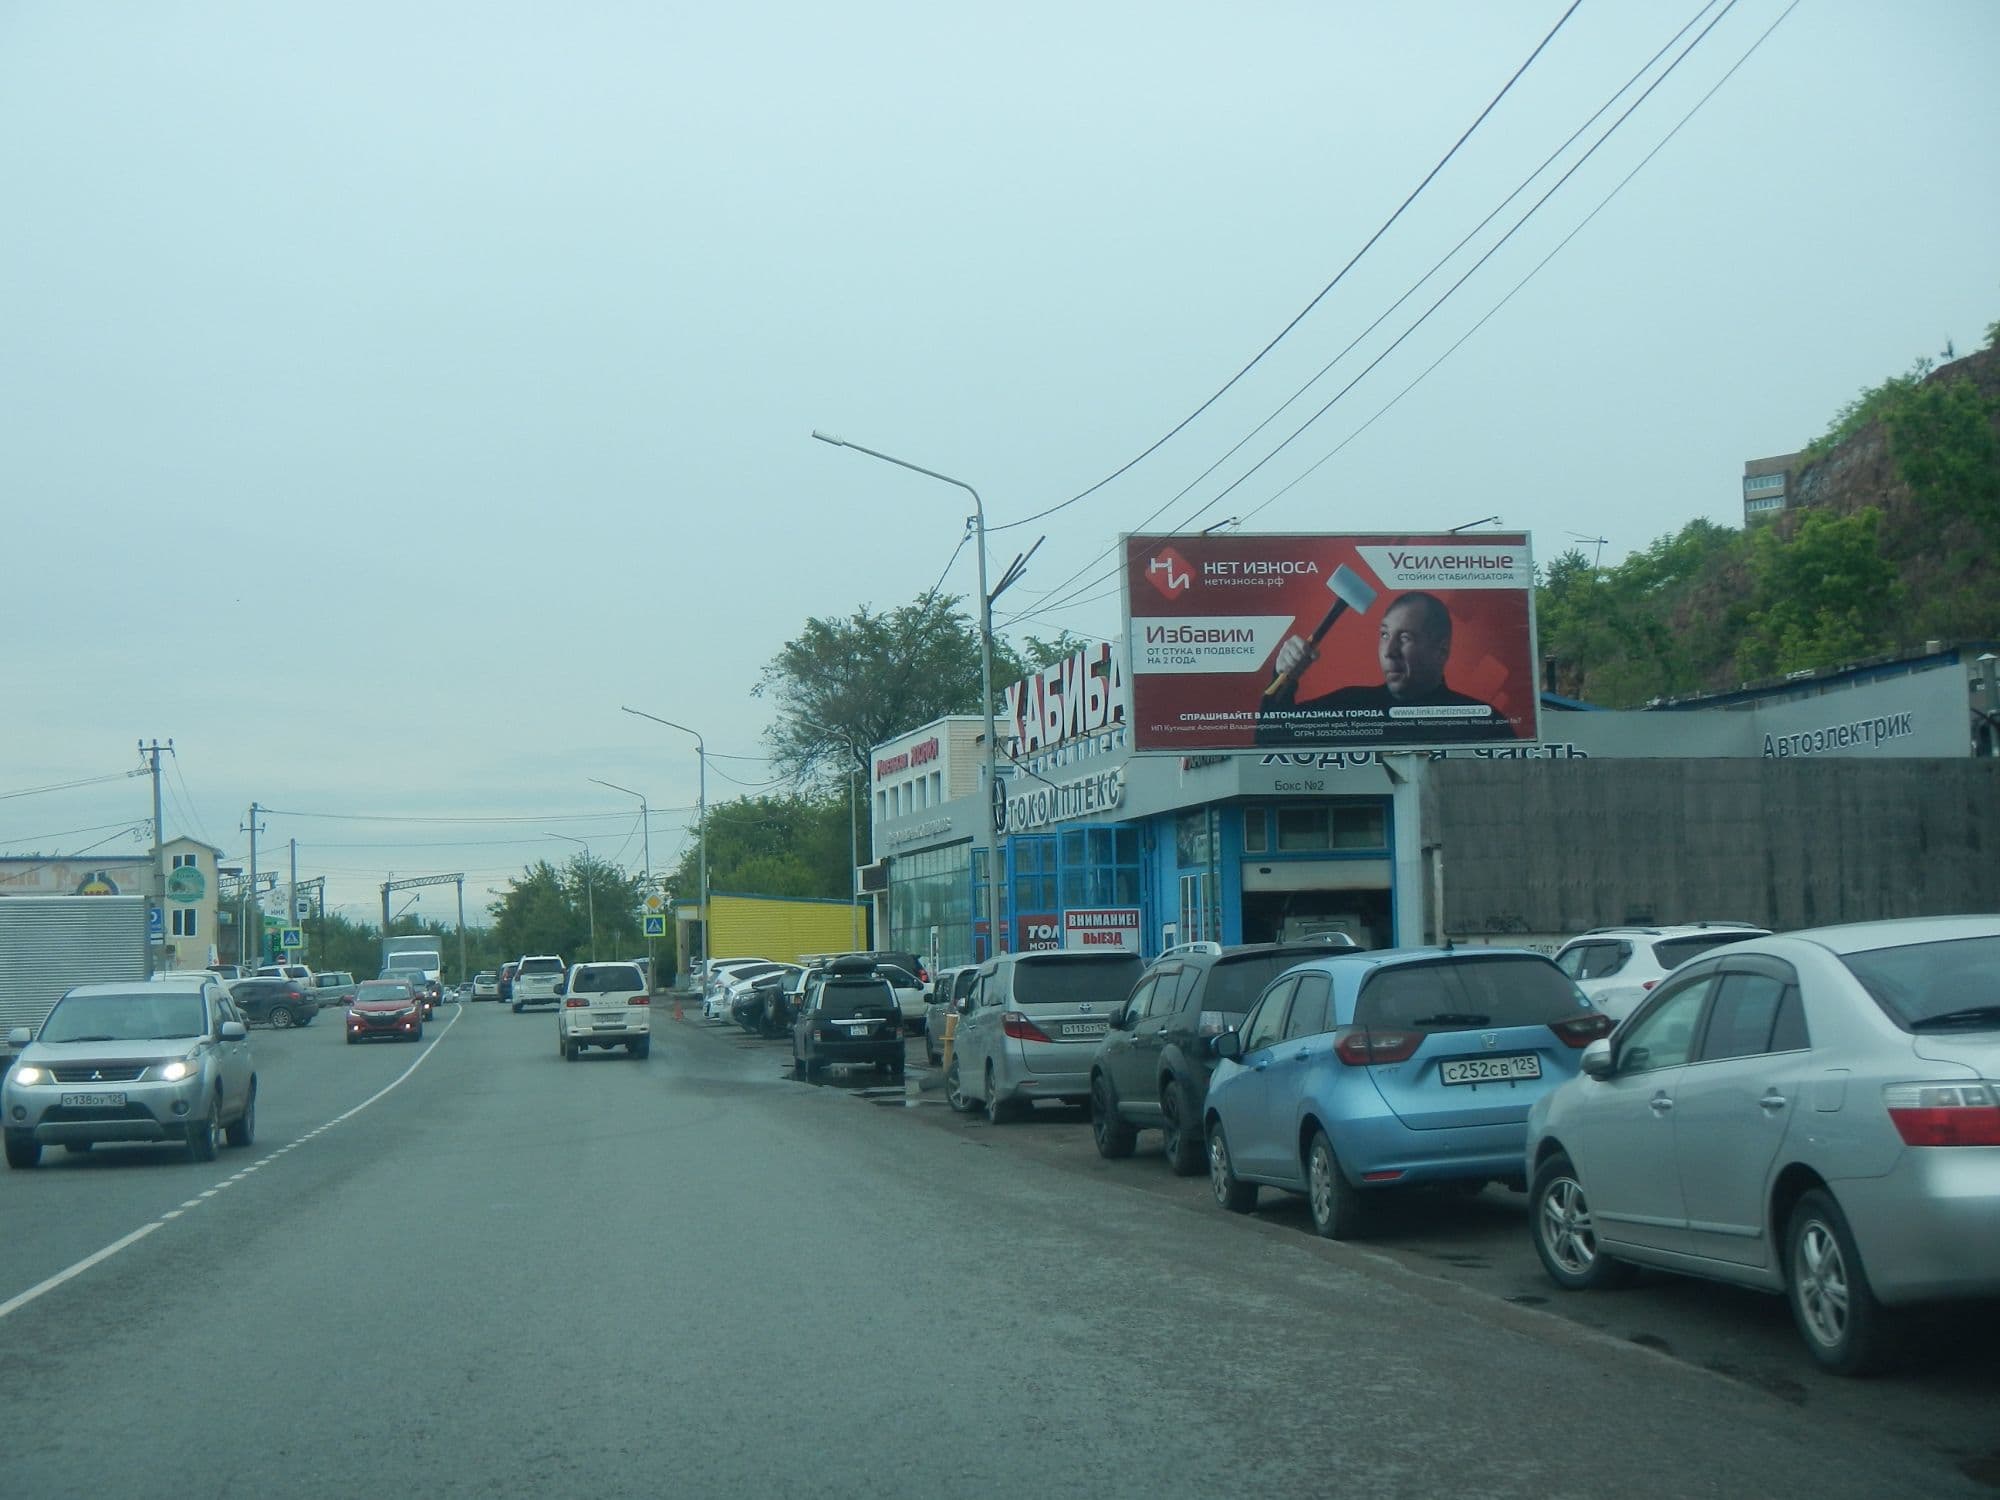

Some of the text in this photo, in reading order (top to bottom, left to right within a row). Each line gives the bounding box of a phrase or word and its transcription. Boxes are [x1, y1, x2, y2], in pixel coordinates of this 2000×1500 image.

[1388, 552, 1514, 570] Усиленные
[1204, 561, 1318, 574] НЕТ ИЗНОСА
[1204, 576, 1285, 588] нетизноса.рф
[1397, 572, 1514, 581] СТОЙКИ СТАБИЛИЗАТОРА
[1146, 626, 1254, 644] Избавим
[1147, 646, 1255, 655] ОТ СТУКА В ПОДВЕСКЕ
[1179, 711, 1252, 721] СПРАШИВАЙТЕ
[1263, 710, 1344, 719] АВТОМАГАЗИНАХ
[1345, 709, 1384, 718] ГОРОДА
[1762, 711, 1913, 759] Автоэлектрик
[1275, 780, 1324, 791] Бокс №2
[1069, 914, 1136, 926] ВНИМАНИЕ!
[1083, 932, 1122, 945] ВЫЕЗД
